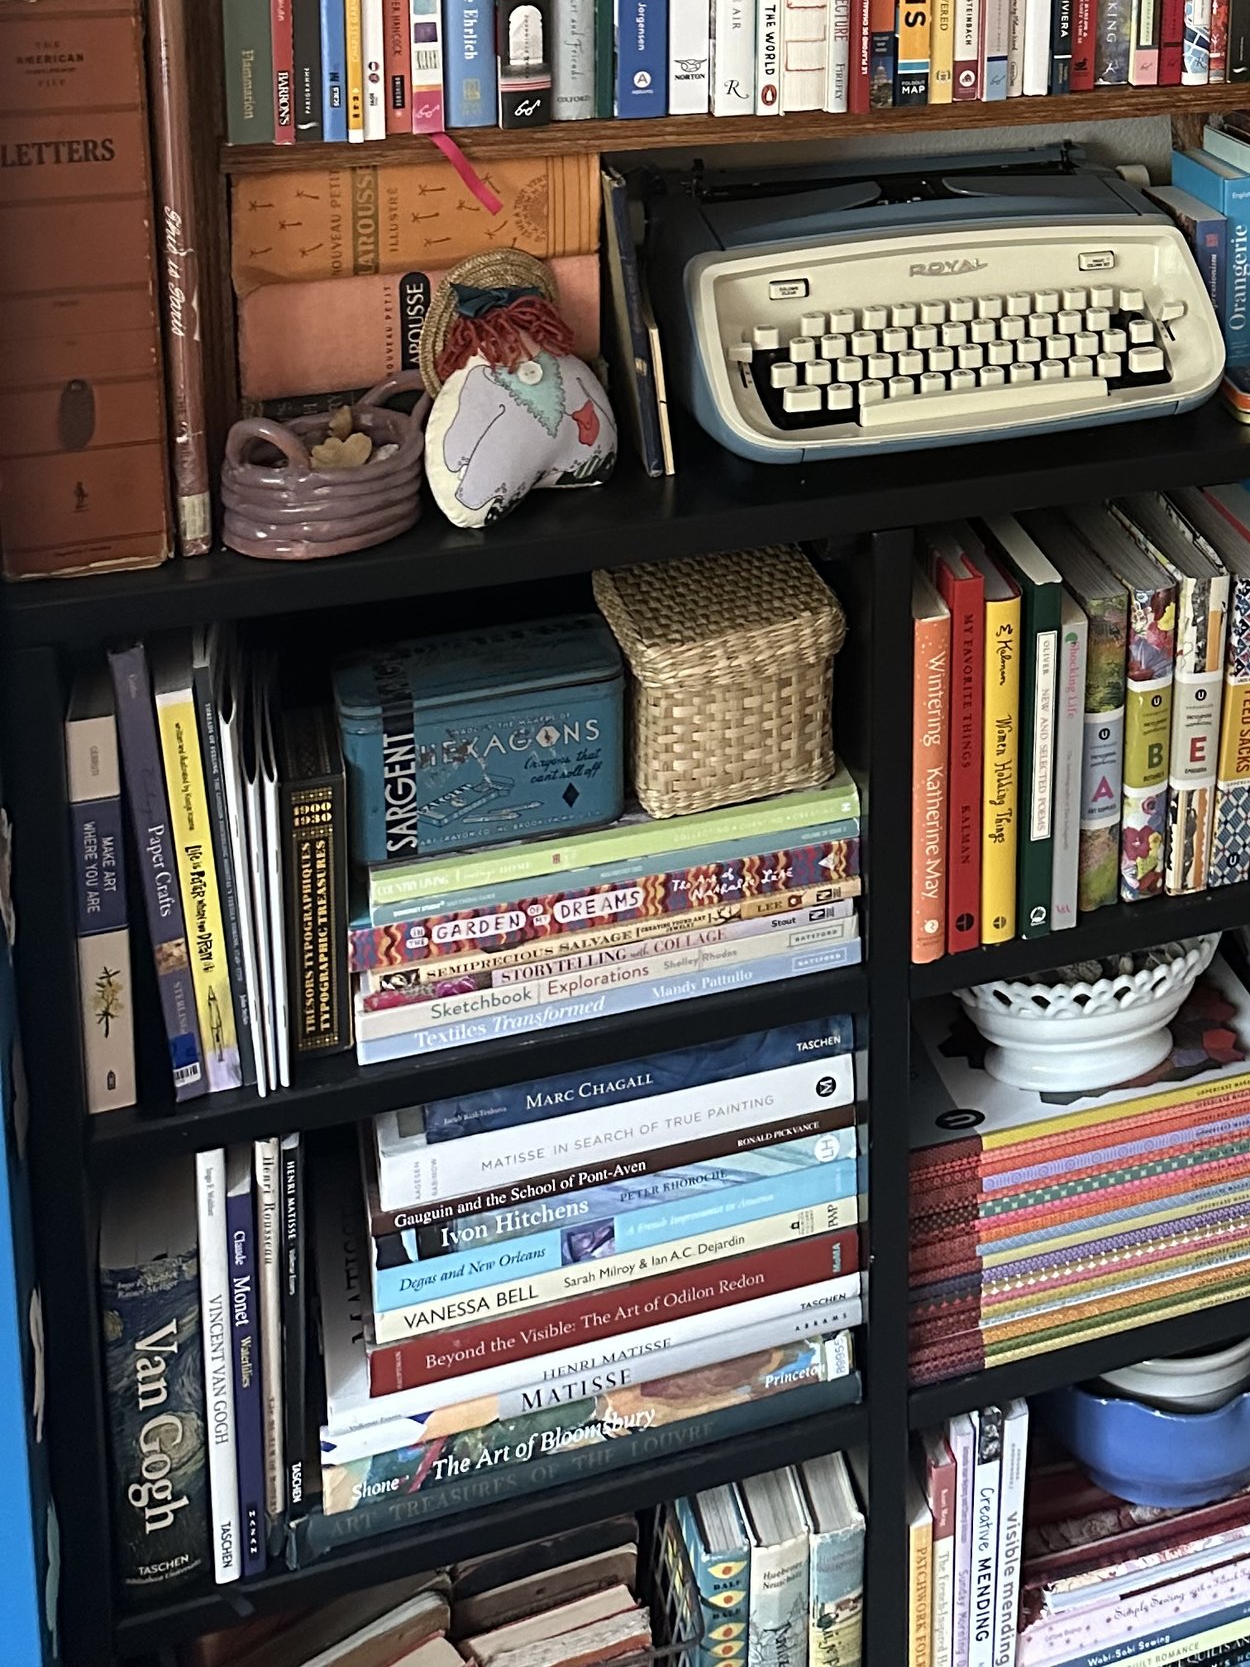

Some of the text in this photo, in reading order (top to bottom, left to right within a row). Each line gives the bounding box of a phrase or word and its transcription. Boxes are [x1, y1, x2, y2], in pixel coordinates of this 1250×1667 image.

[463, 9, 479, 60] Ehrlich
[636, 3, 648, 51] Jorgensen
[732, 9, 742, 30] AIR
[1106, 3, 1118, 43] KING
[16, 53, 84, 65] AMERICAN
[675, 73, 706, 81] NORTON
[241, 49, 254, 119] Flammarion
[902, 85, 926, 94] MAP
[1, 139, 115, 169] LETTERS
[909, 258, 988, 277] ROYAL
[1229, 224, 1250, 331] Orangerie
[960, 613, 974, 865] MY FAVORITE THINGS KALMAN
[1148, 743, 1163, 770] B
[1189, 736, 1207, 763] E
[383, 733, 418, 852] SARGENT
[921, 651, 946, 900] Wintering Katherine May
[1091, 775, 1114, 803] A
[293, 801, 332, 816] 1900
[294, 813, 333, 828] 1930
[148, 824, 171, 918] Paper Crafts
[437, 890, 640, 940] GARDEN DREAMS
[757, 901, 783, 913] LEE
[427, 929, 632, 978] SEMIPRECIOUS SALVAGE
[415, 969, 753, 1048] Textiles Transformed Mandy Pattullo
[431, 949, 738, 1020] Sketchbook Explorations Shelley Rhodes
[796, 1035, 842, 1051] TASCHEN
[481, 1095, 775, 1172] MATISSE IN SEARCH OF TRUE PAINTING
[394, 1159, 647, 1228] Gauguin and the School of Pont-Aven
[441, 1199, 589, 1247] Ivon Hitchens
[399, 1247, 546, 1291] Degas and New Orleans
[233, 1230, 250, 1389] Claude Monet Waterlilies
[403, 1284, 539, 1329] VANESSA BELL
[426, 1271, 765, 1369] Beyond the Visible: The Art of Odilon Redon
[208, 1294, 230, 1445] VINCENT VAN GOGH
[543, 1337, 672, 1380] HENRI MATISSE
[522, 1368, 632, 1412] MATISSE
[127, 1319, 190, 1535] Van Gogh
[351, 1406, 656, 1502] Shone The Art of Bloomsbury
[290, 1461, 302, 1504] TASCHEN
[138, 1554, 190, 1576] TASCHEN
[218, 1521, 233, 1568] TASCHEN
[975, 1487, 995, 1642] Creative MENDING
[995, 1511, 1020, 1667] visible mending
